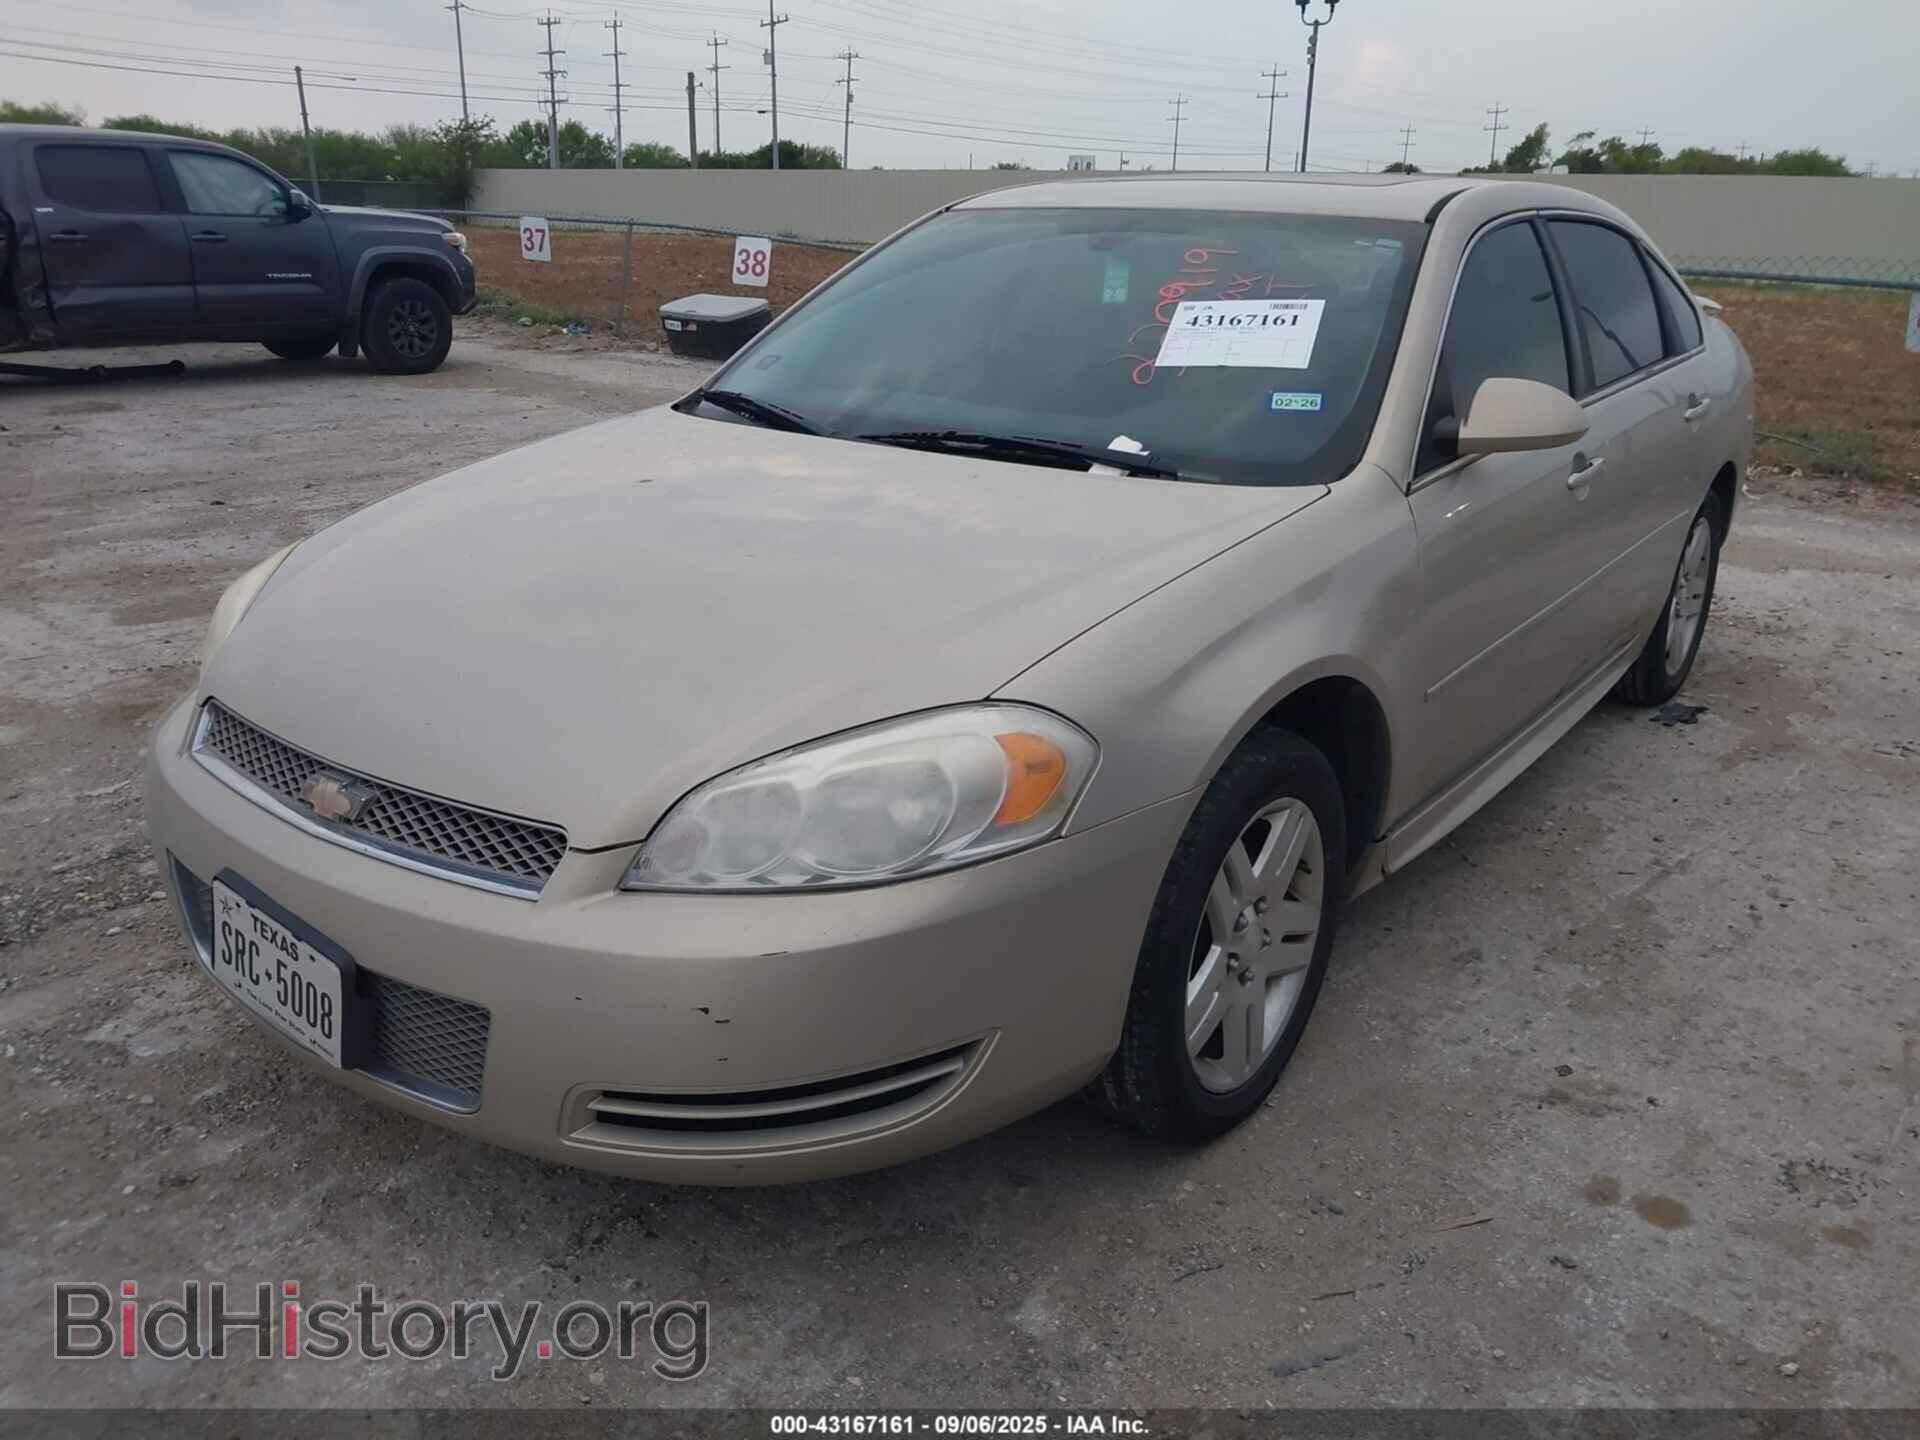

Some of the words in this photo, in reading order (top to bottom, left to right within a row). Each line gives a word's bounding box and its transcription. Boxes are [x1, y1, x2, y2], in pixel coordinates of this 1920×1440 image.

[523, 228, 545, 252] 37
[736, 249, 766, 277] 38
[1185, 314, 1299, 328] 43167161
[250, 913, 299, 962] TEXAS
